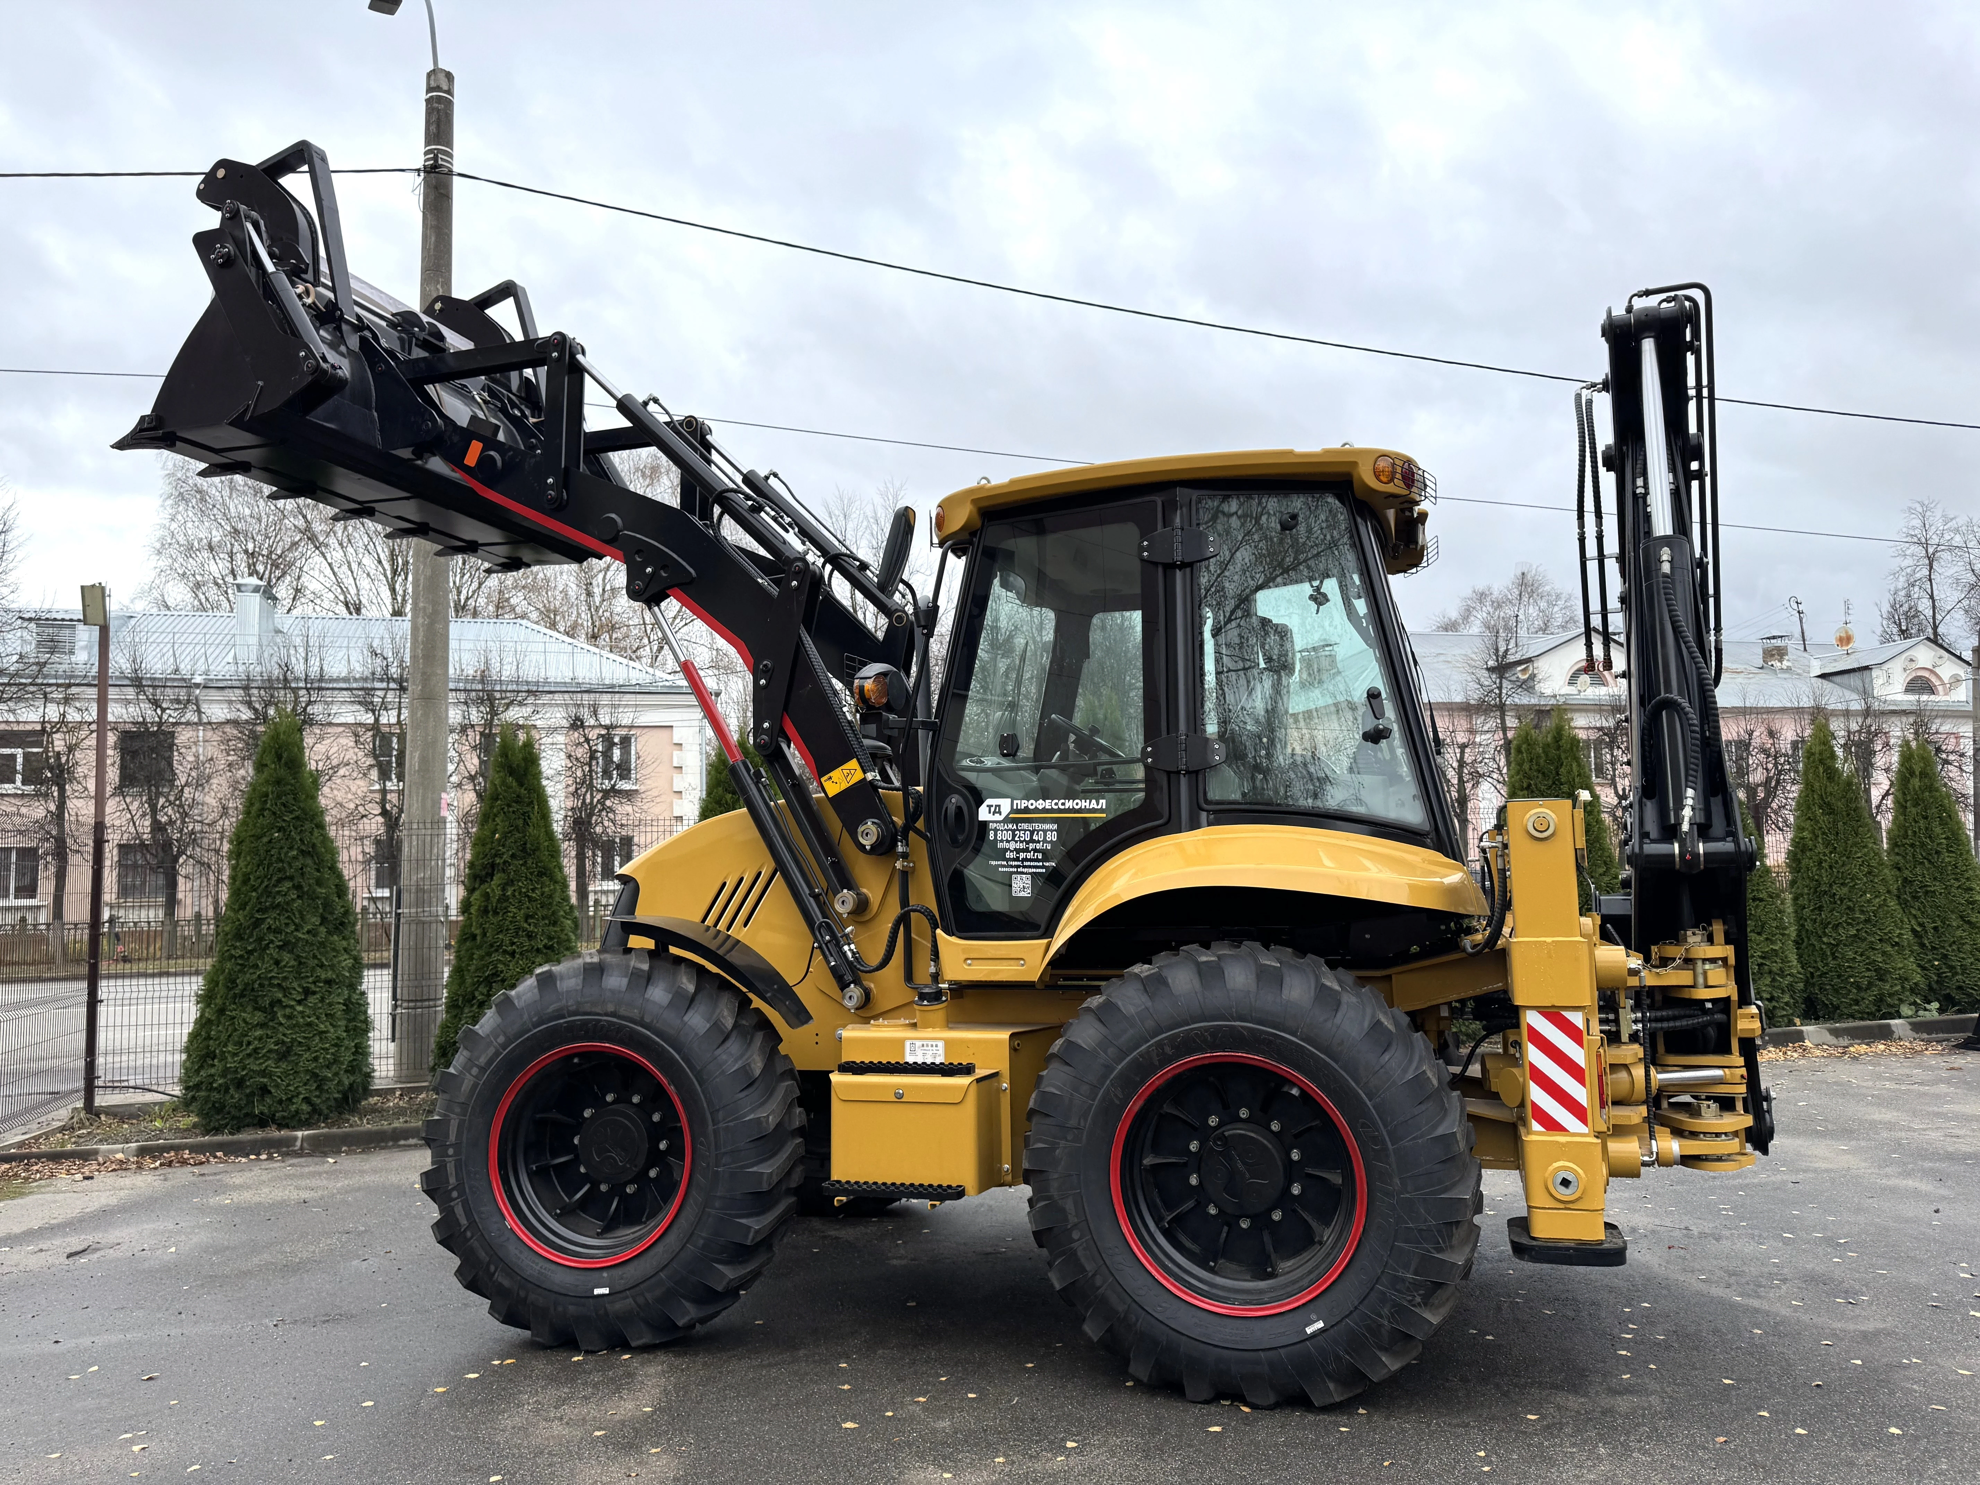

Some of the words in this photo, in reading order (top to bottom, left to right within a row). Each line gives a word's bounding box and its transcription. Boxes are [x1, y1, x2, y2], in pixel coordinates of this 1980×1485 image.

[986, 804, 1002, 816] ТД
[1013, 799, 1106, 810] ПРОФЕССИОНАЛ
[989, 831, 994, 840] 8
[997, 831, 1012, 840] 800
[1015, 831, 1030, 841] 250
[1033, 831, 1044, 841] 40
[1046, 831, 1057, 841] 80
[998, 841, 1051, 850] info@dst-prof.ru
[1006, 851, 1042, 860] dst-prof.ru
